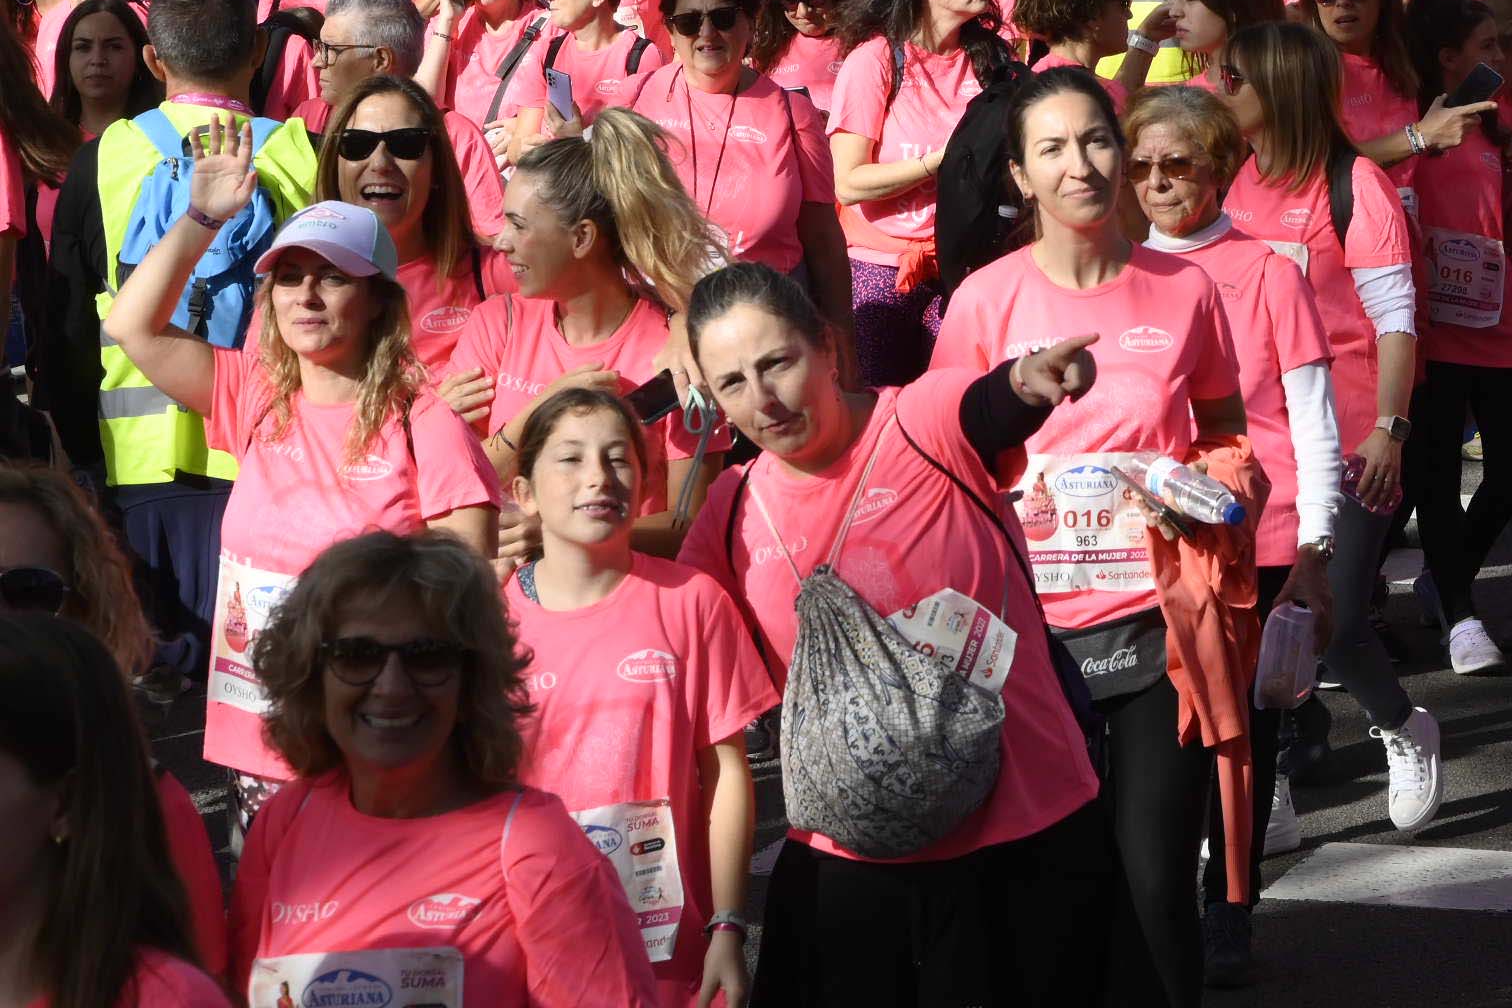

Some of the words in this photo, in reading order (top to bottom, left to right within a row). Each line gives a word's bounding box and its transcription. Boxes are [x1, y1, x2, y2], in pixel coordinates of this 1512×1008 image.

[1440, 266, 1473, 284] 016
[1122, 335, 1171, 347] ASTURIANA
[1060, 478, 1113, 490] ASTURIANA
[1064, 509, 1112, 528] 016
[1076, 535, 1098, 547] 963
[1071, 552, 1085, 561] DE
[1086, 552, 1097, 561] LA
[1098, 551, 1128, 560] MUJER
[1035, 572, 1070, 583] YSHO
[1108, 570, 1152, 581] Santande
[626, 817, 660, 833] SUMA
[646, 912, 670, 926] 2023
[401, 976, 446, 990] SUMA
[308, 987, 386, 1008] ASTURIANA
